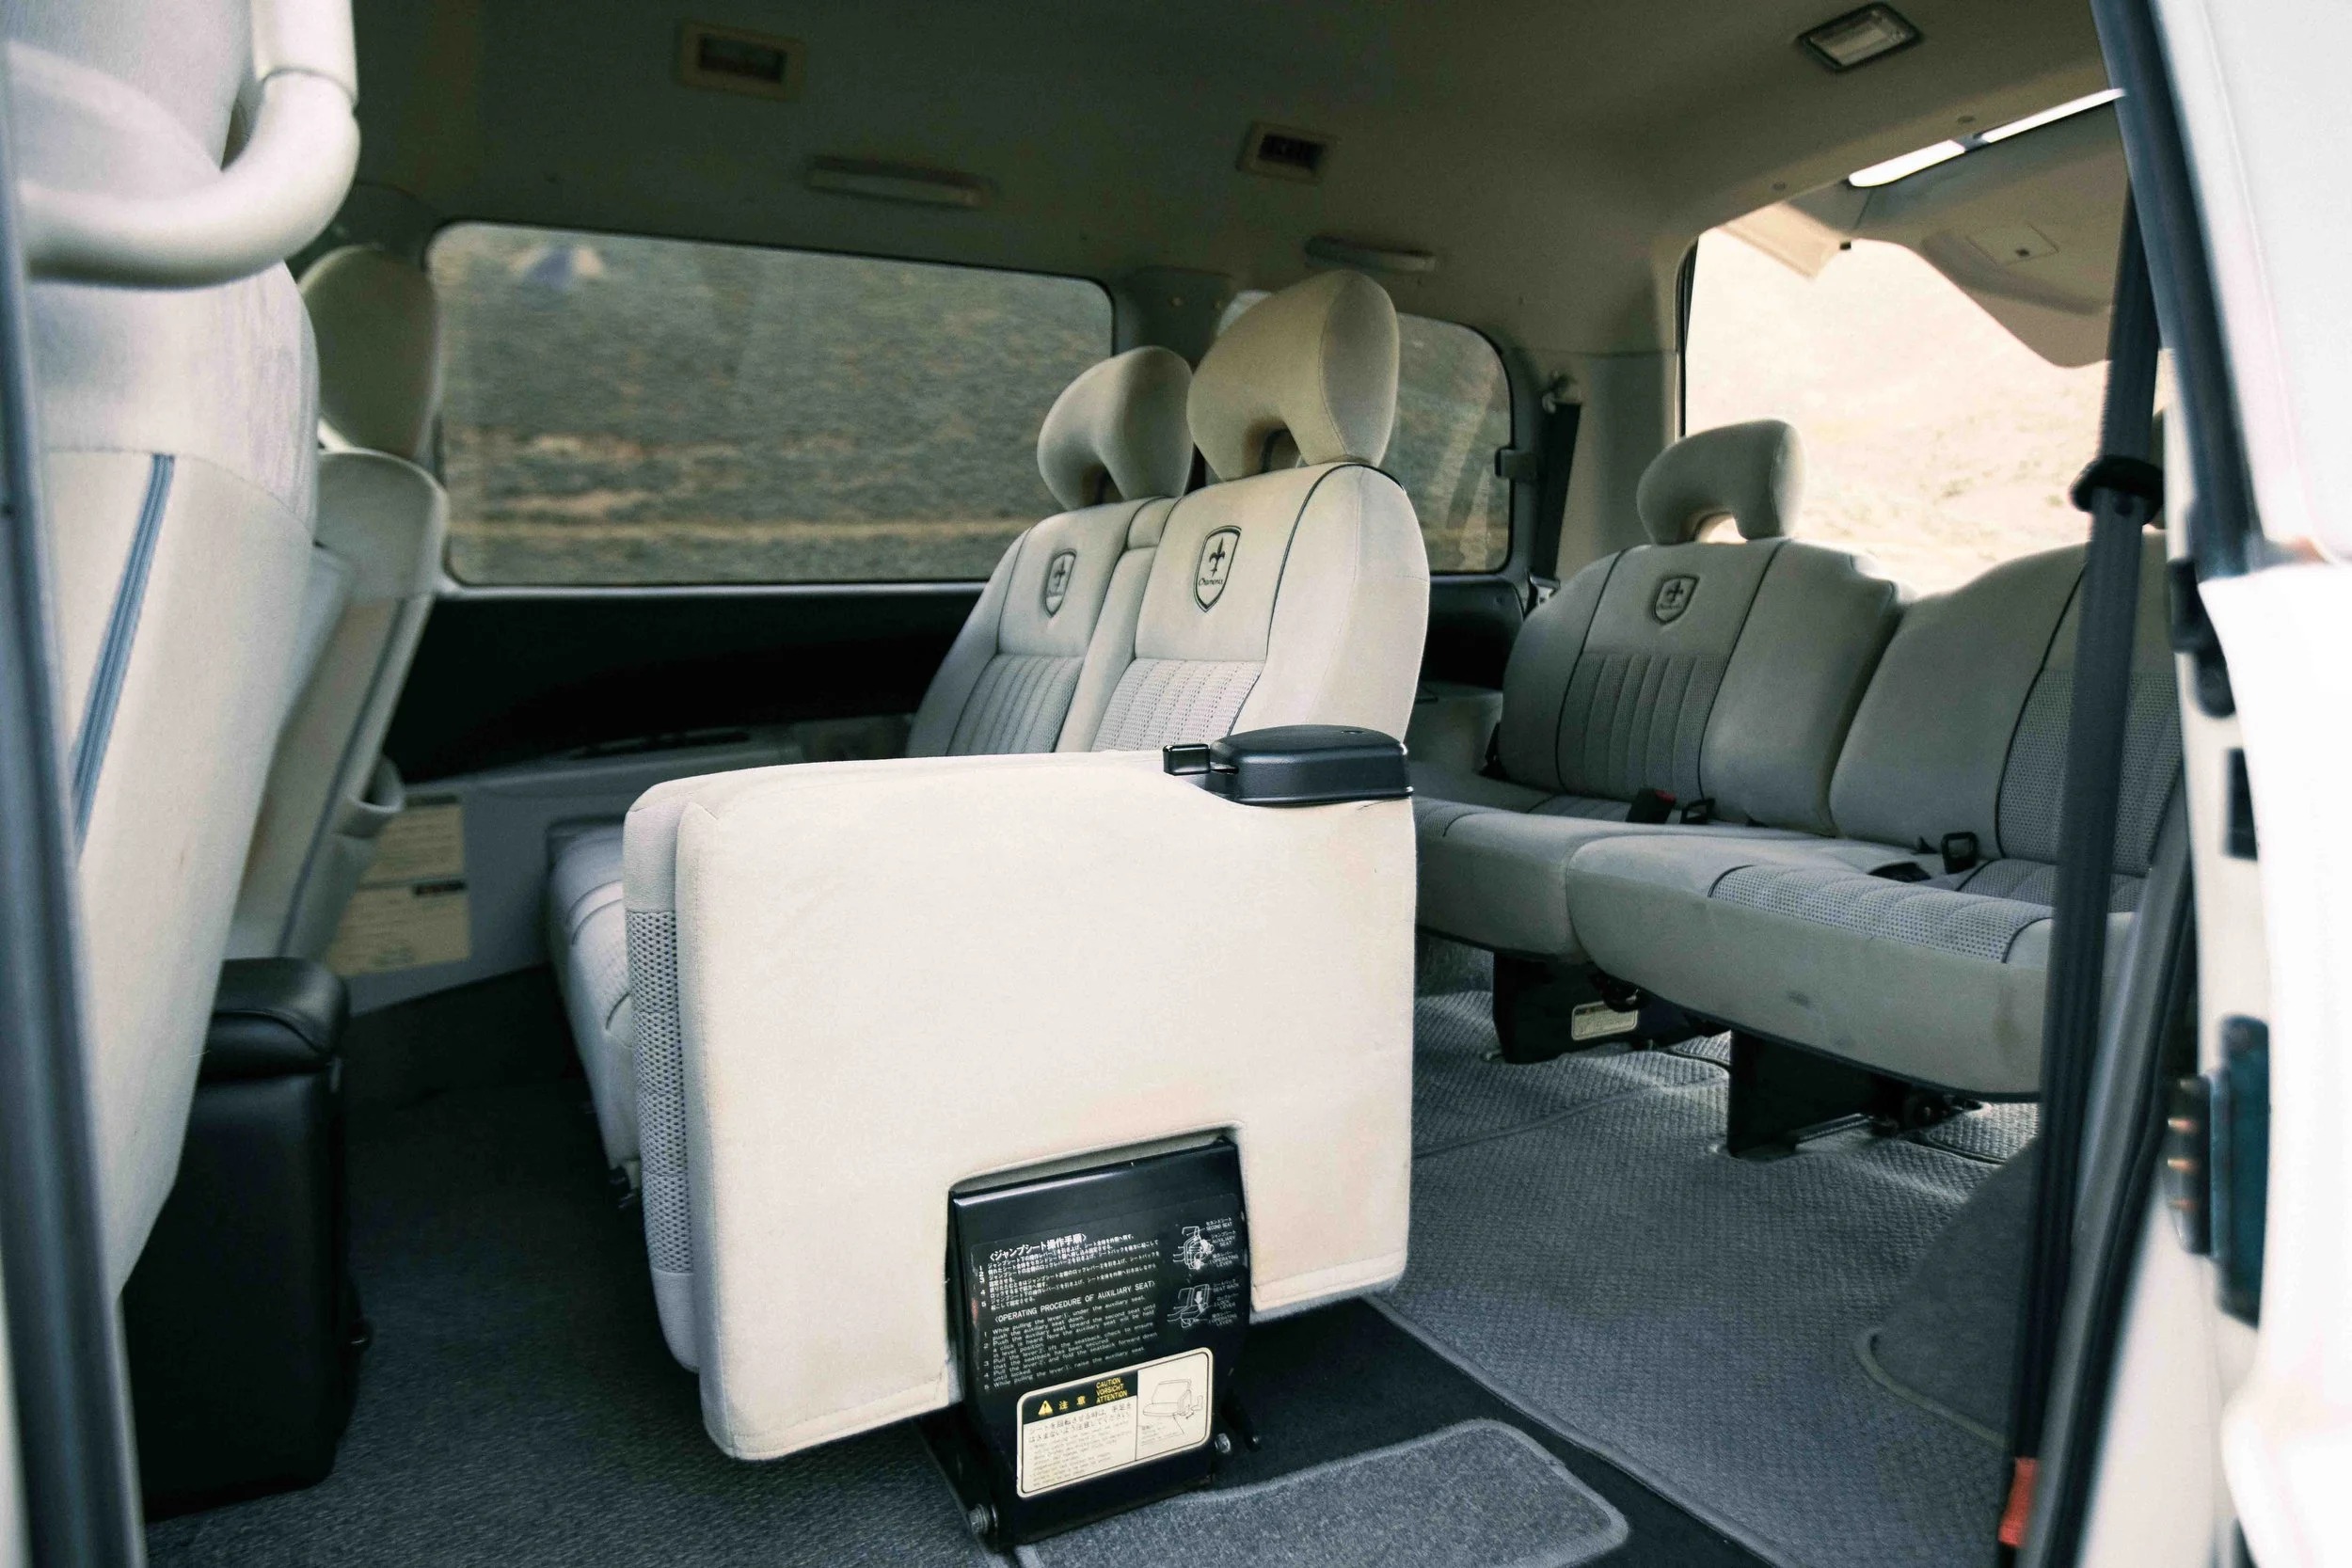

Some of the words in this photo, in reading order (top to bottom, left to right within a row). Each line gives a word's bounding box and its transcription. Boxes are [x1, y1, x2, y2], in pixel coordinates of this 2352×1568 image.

[1041, 1297, 1082, 1313] PROCEDURE
[1085, 1294, 1094, 1303] OF
[1098, 1286, 1132, 1300] AUXILIARY
[1012, 1322, 1032, 1331] pulling
[993, 1338, 1009, 1347] Push
[1097, 1377, 1121, 1389] CAUTION
[1097, 1384, 1124, 1396] VORSICHT
[1097, 1390, 1127, 1404] ATTENTION
